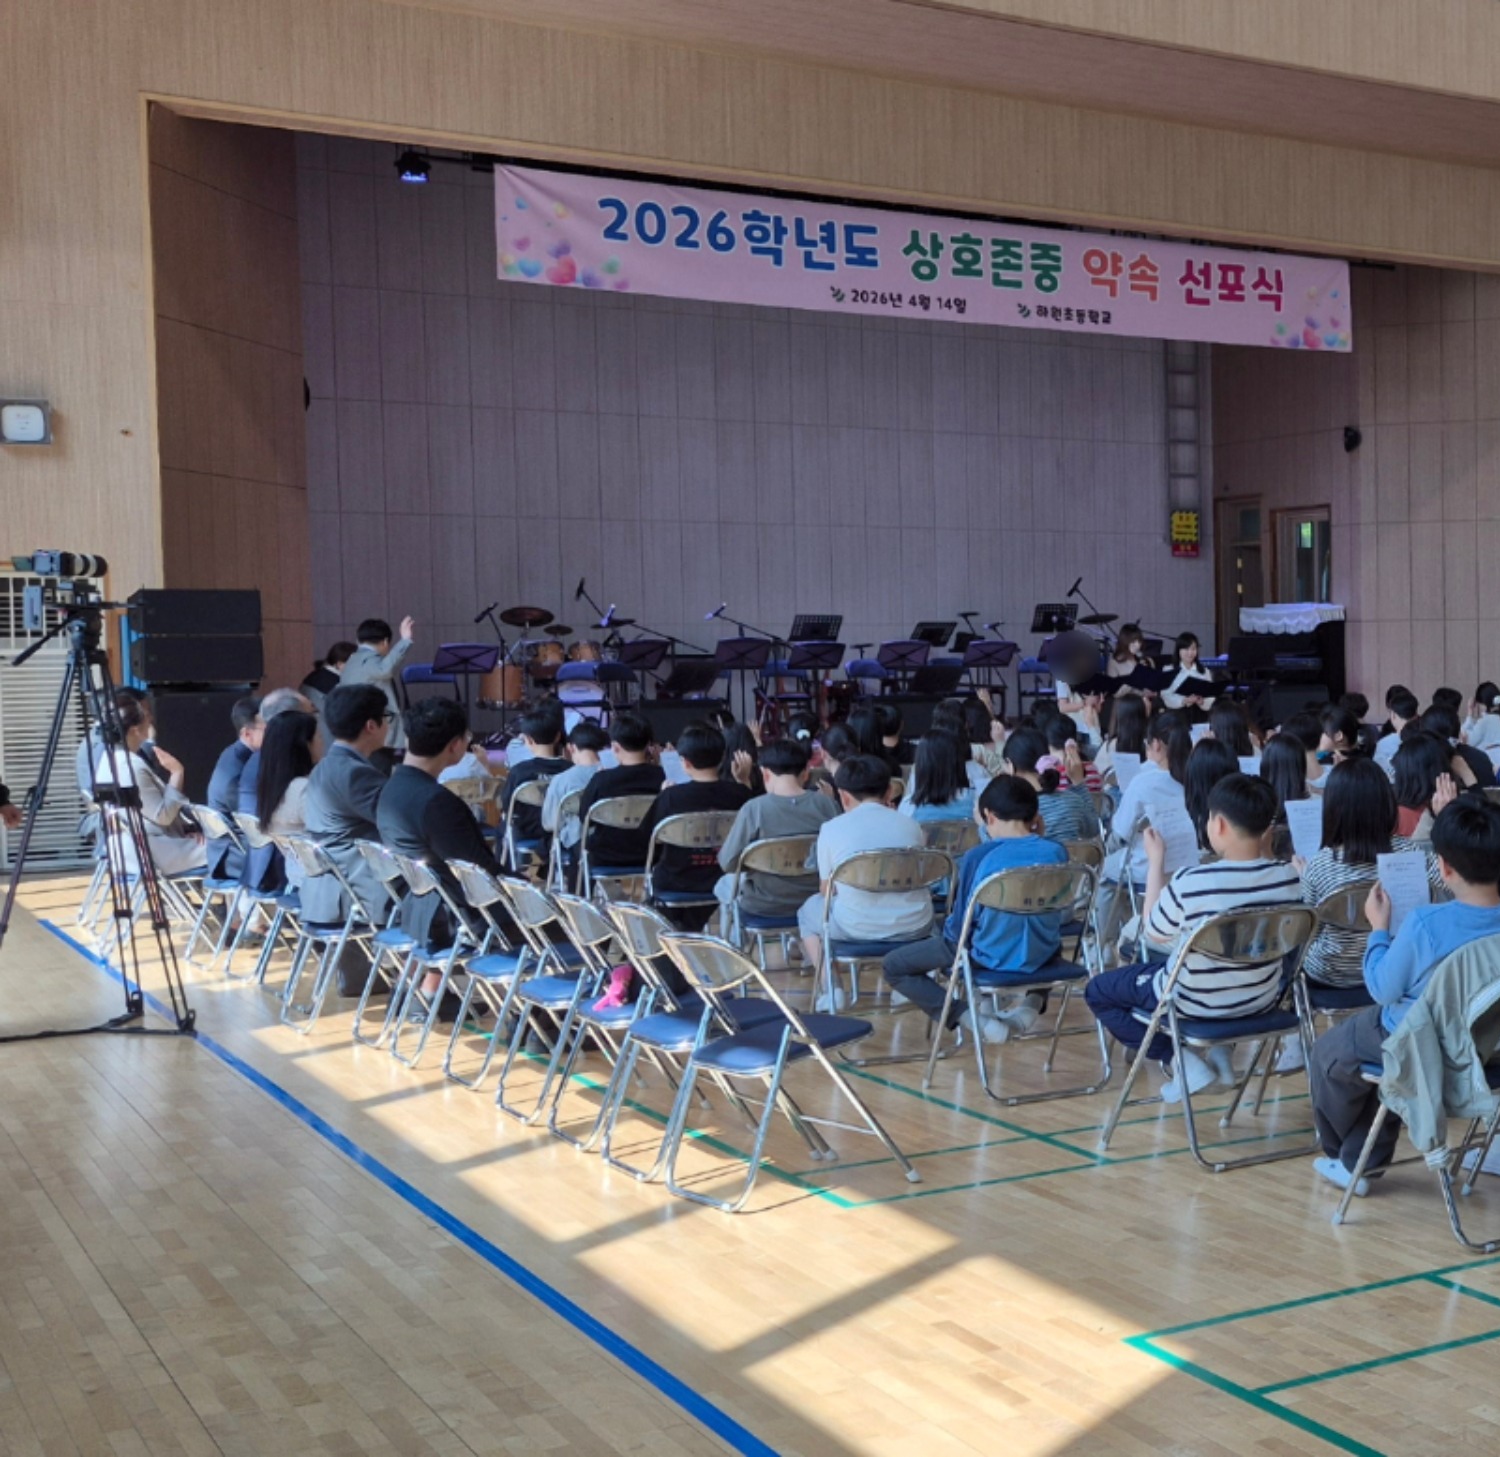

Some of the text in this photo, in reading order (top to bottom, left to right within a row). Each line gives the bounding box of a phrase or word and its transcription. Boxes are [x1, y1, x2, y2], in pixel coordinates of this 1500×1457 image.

[598, 197, 1284, 312] 2026학년도 상호존중 약속 선포식
[850, 288, 967, 314] 2026년 4월 14일
[1036, 304, 1112, 325] 하원초등학교
